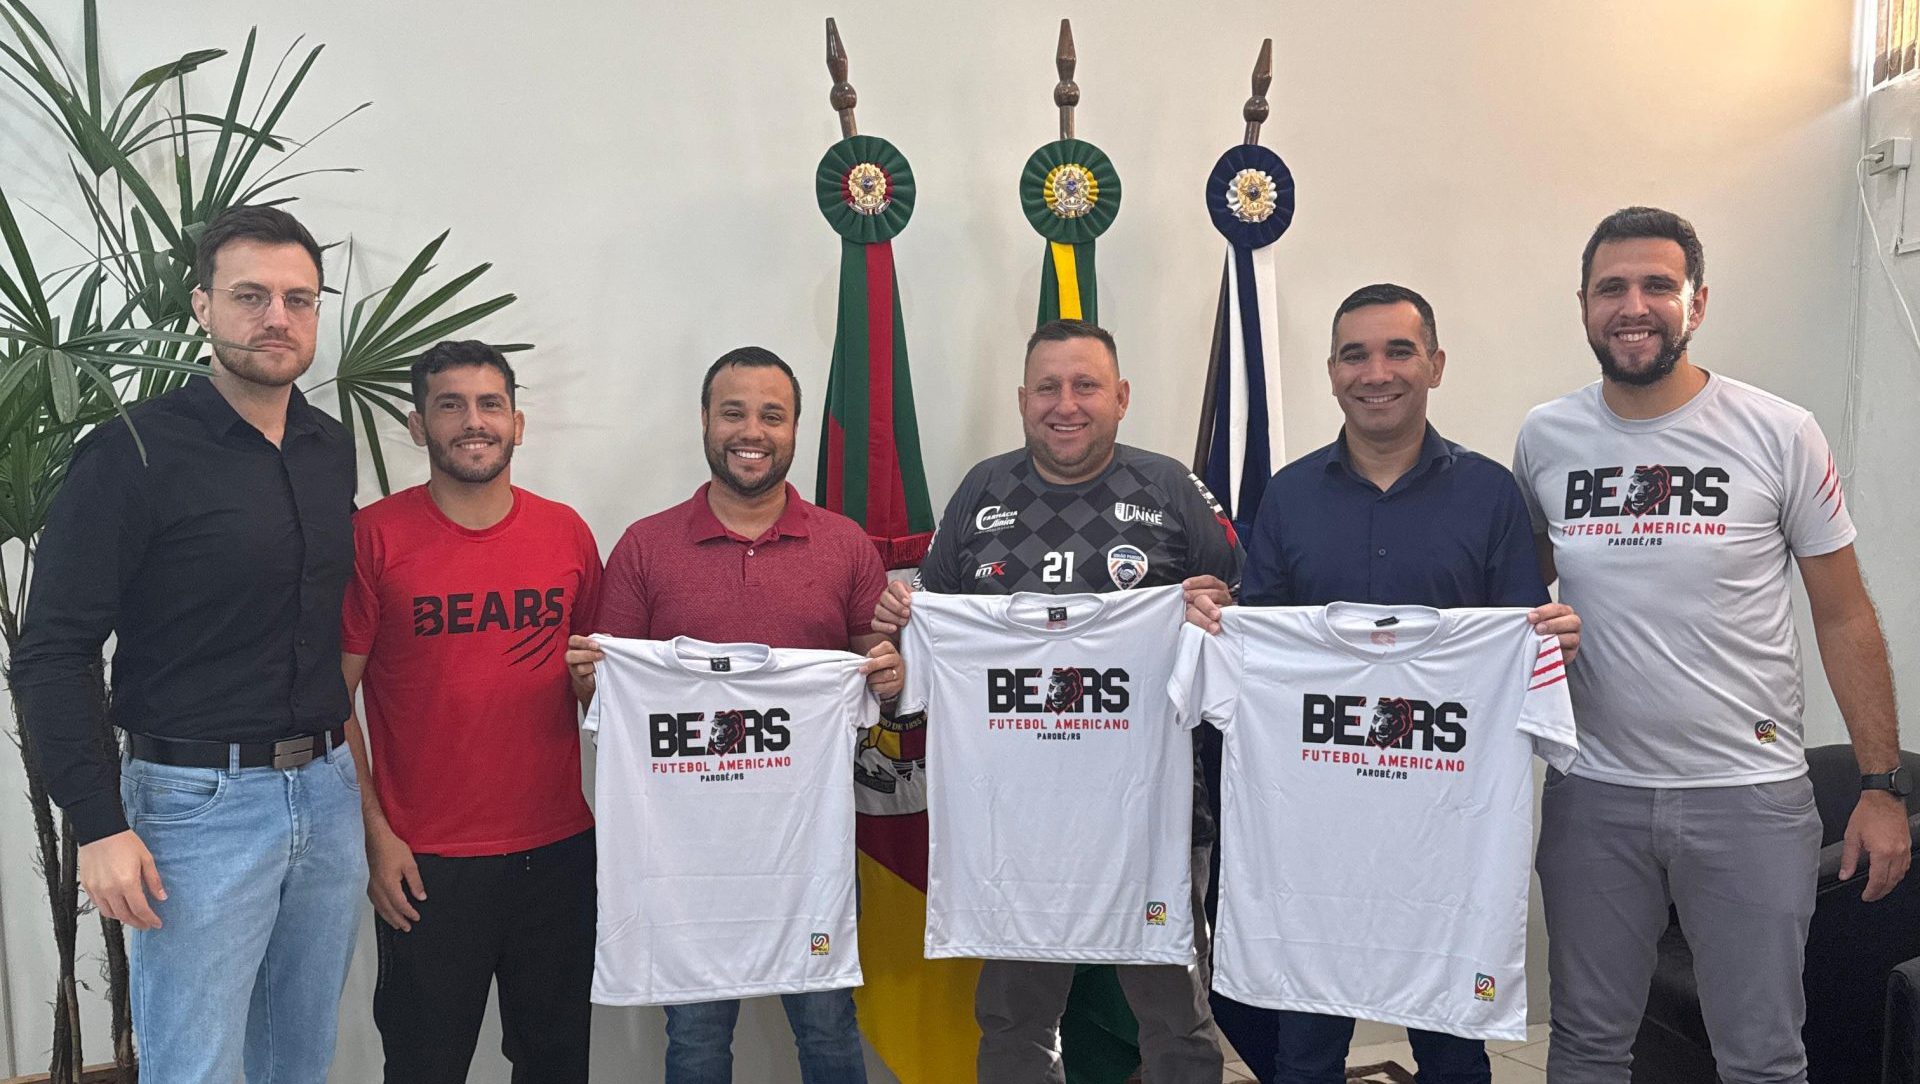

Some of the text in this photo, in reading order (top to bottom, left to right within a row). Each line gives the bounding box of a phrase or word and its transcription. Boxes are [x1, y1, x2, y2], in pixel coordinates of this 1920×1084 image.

[1565, 464, 1730, 520] BEARS
[1562, 521, 1727, 537] FUTEBOL AMERICANO
[1608, 536, 1662, 546] PAROBÉ/RS
[1043, 551, 1075, 582] 21
[413, 588, 565, 636] BEARS
[987, 667, 1130, 714] BEARS
[649, 708, 791, 757] BEARS
[989, 719, 1130, 730] FUTEBOL AMERICANO
[1302, 693, 1468, 754] BEARS
[1037, 732, 1081, 741] PAROBÉ/RS
[652, 756, 792, 774] FUTEBOL AMERICANO
[1302, 749, 1465, 772] FUTEBOL AMERICANO
[700, 772, 745, 782] PAROBÉ/RS
[1357, 768, 1408, 780] PAROBÉ/RS
